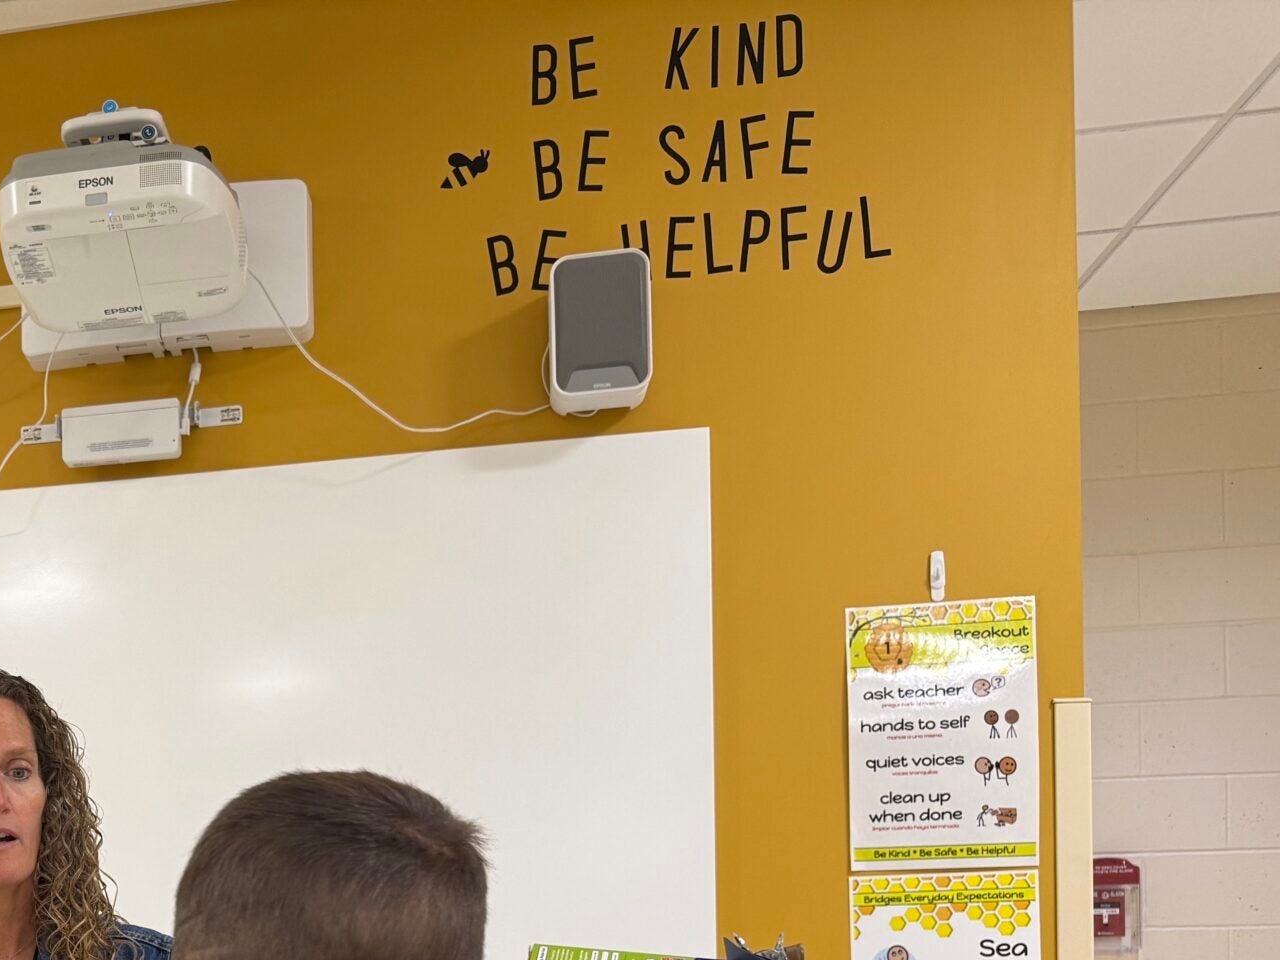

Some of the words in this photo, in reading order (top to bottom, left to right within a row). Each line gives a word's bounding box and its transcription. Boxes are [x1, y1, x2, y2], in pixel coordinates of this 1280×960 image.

[531, 35, 598, 106] BE
[664, 13, 804, 91] KIND
[533, 129, 610, 202] BE
[658, 110, 815, 186] SAFE
[78, 176, 114, 189] EPSON
[486, 228, 568, 297] BE
[620, 196, 892, 280] HELPFUL
[103, 305, 143, 316] EPSON
[953, 626, 1030, 639] Breakout
[884, 641, 890, 655] 1
[863, 687, 895, 701] ask
[898, 684, 965, 699] teacher
[860, 718, 914, 733] hands
[918, 718, 936, 730] to
[940, 715, 971, 729] self
[865, 755, 908, 772] quiet
[912, 754, 965, 767] voices
[880, 791, 925, 805] clean
[928, 792, 951, 806] up
[869, 810, 915, 823] when
[919, 808, 963, 821] done
[873, 850, 886, 858] Be
[888, 849, 910, 858] Kind
[919, 849, 932, 857] Be
[934, 848, 957, 856] Safe
[966, 847, 979, 856] Be
[981, 845, 1016, 857] Helpful
[863, 895, 902, 905] Bridges
[904, 893, 954, 904] Everyday
[956, 890, 1024, 902] Expectations
[979, 939, 1028, 957] Sea
